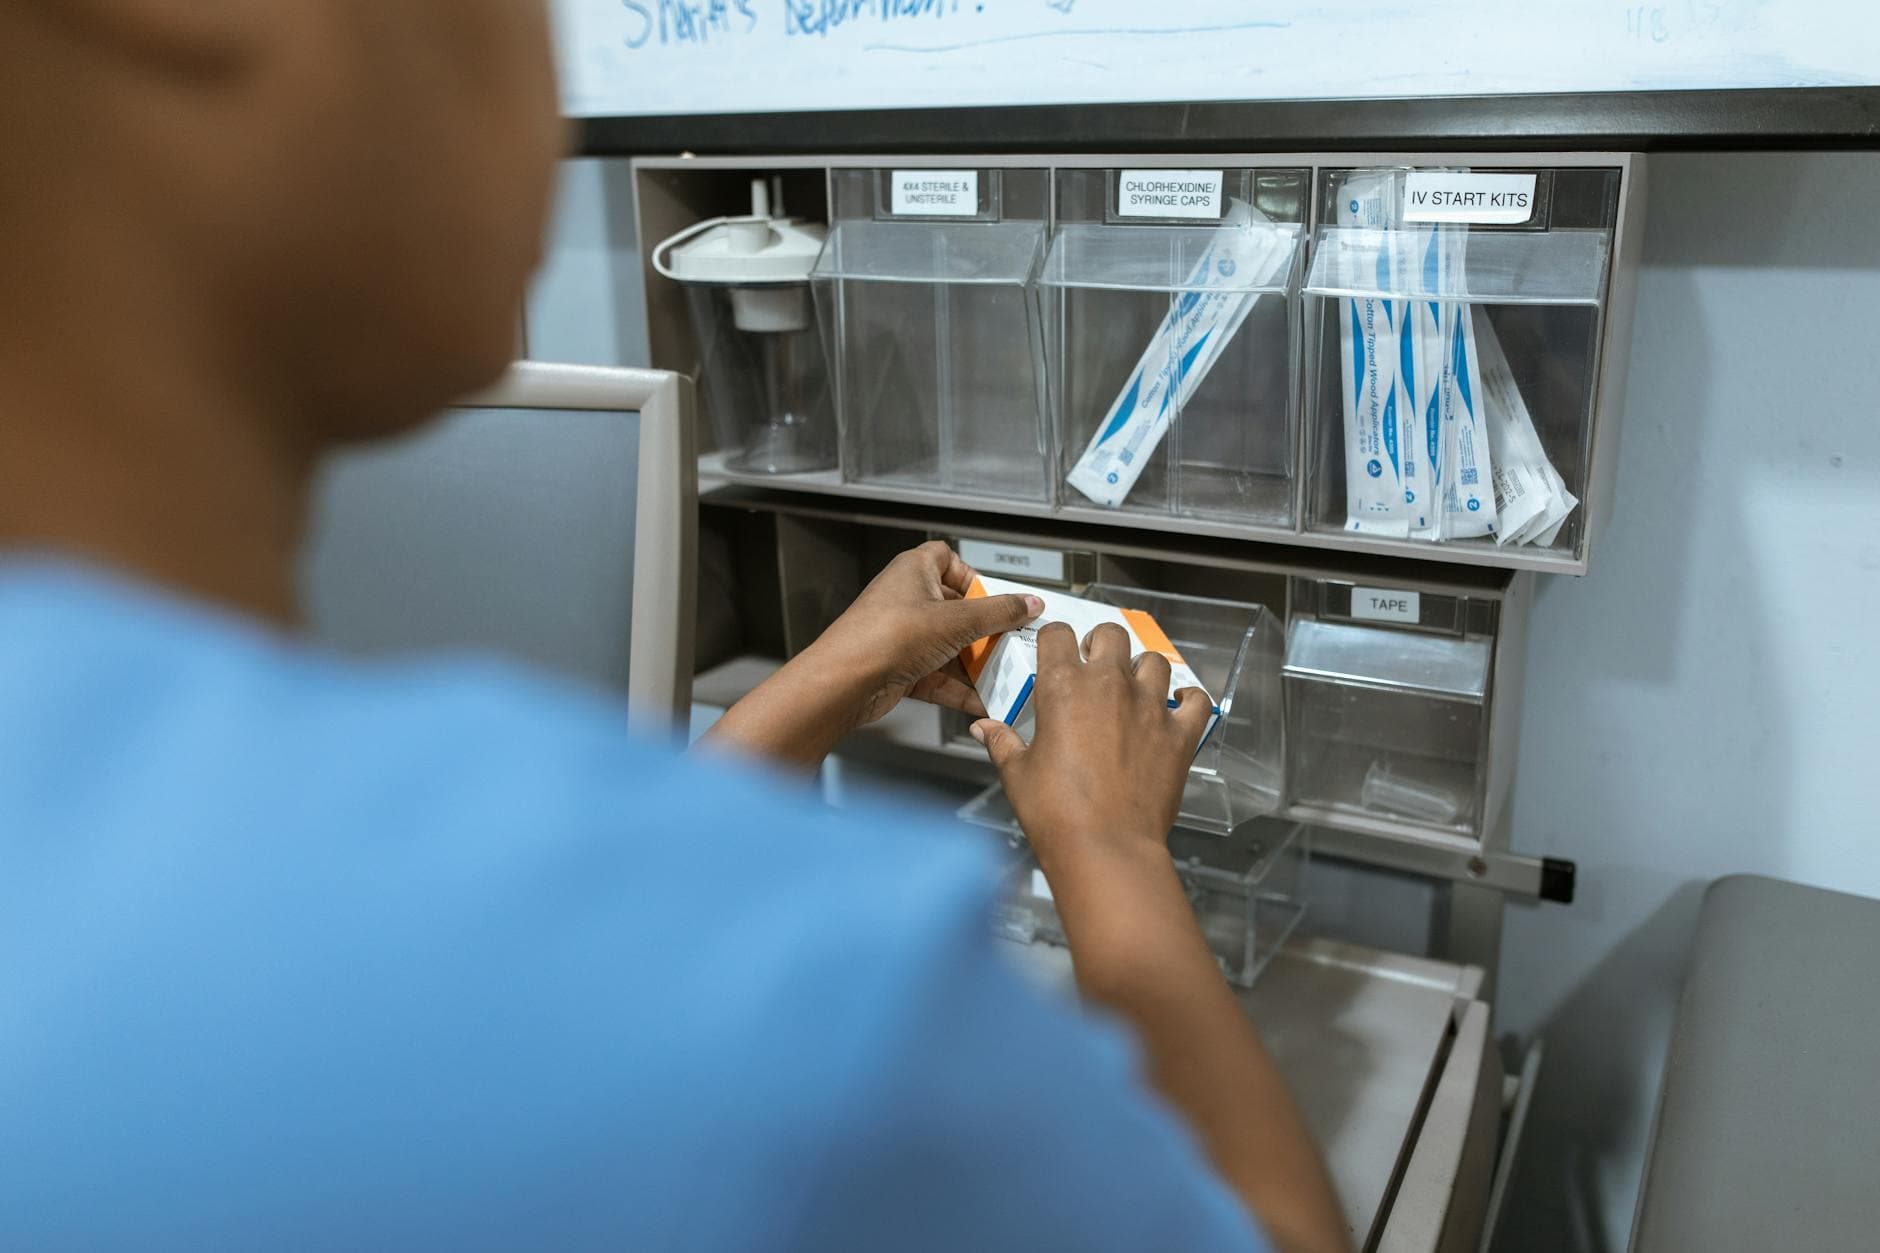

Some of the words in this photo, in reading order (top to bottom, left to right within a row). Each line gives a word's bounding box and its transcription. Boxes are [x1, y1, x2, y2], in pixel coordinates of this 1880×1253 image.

[921, 181, 960, 193] STERILE
[962, 182, 969, 193] &
[1126, 181, 1216, 194] CHLORHEXIDINE/
[905, 194, 957, 205] UNSTERILE
[1130, 195, 1177, 206] SYRINGE
[1181, 196, 1210, 207] CAPS
[1411, 190, 1427, 205] IV
[1431, 191, 1485, 206] START
[1490, 192, 1528, 208] KITS
[1367, 332, 1376, 368] Tipped
[1369, 369, 1378, 400] Wood
[1370, 401, 1381, 457] Applicators
[1369, 598, 1408, 612] TAPE
